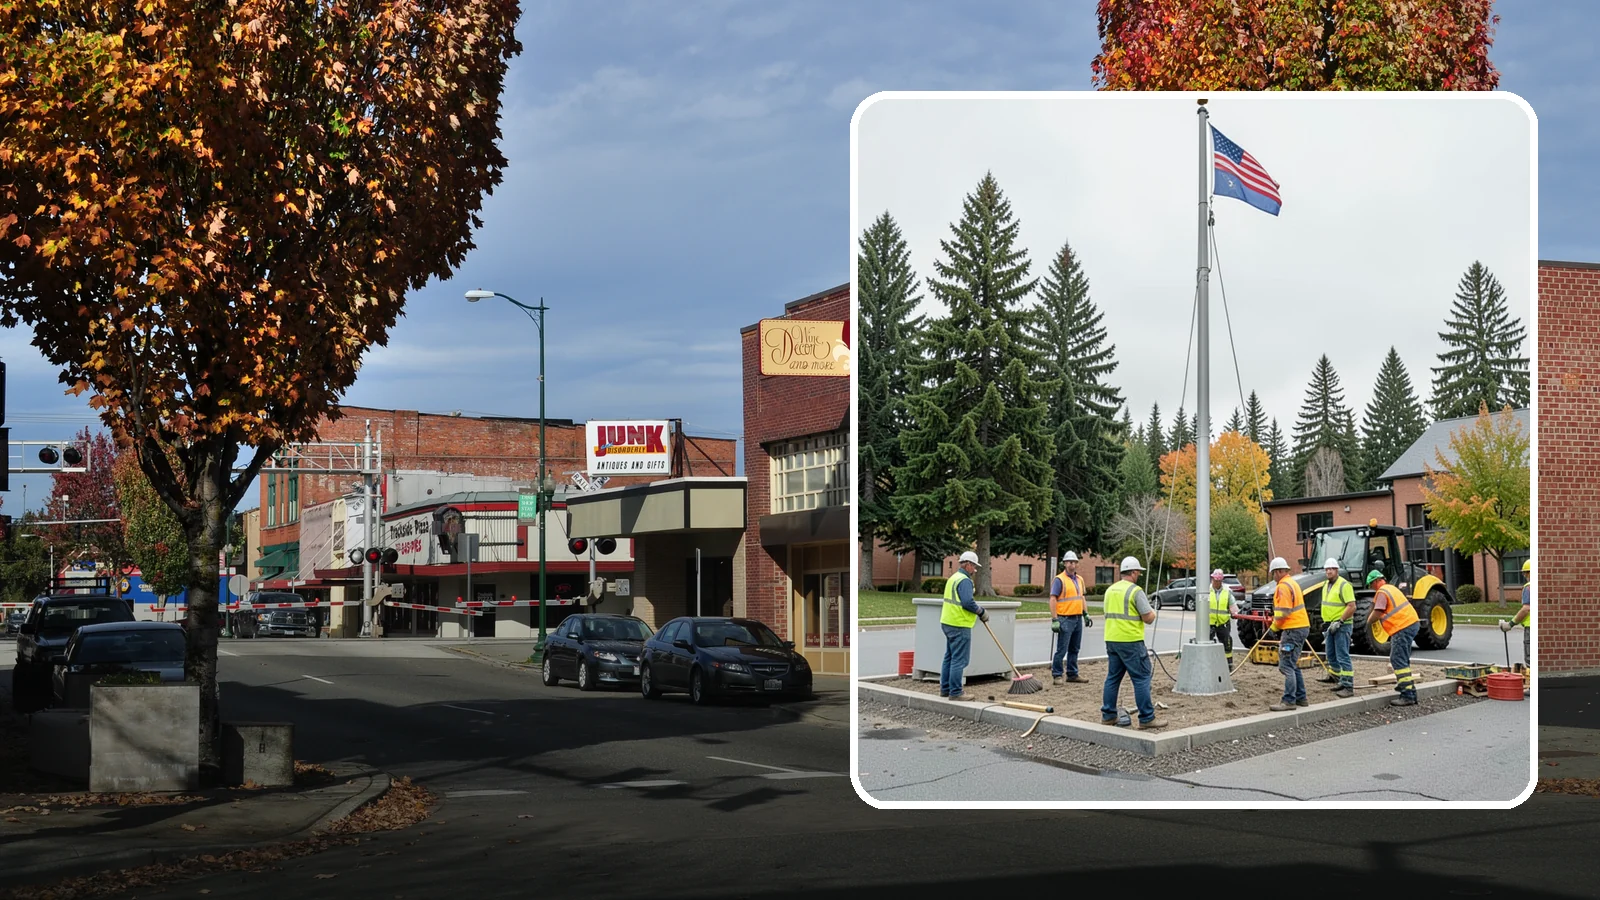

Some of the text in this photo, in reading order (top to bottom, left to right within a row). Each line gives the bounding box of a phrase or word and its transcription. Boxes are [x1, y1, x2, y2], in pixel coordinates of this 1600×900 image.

[596, 425, 665, 457] JUNK
[608, 446, 645, 454] DISORDERLY
[597, 460, 666, 470] ANTIQUES AND GIFTS
